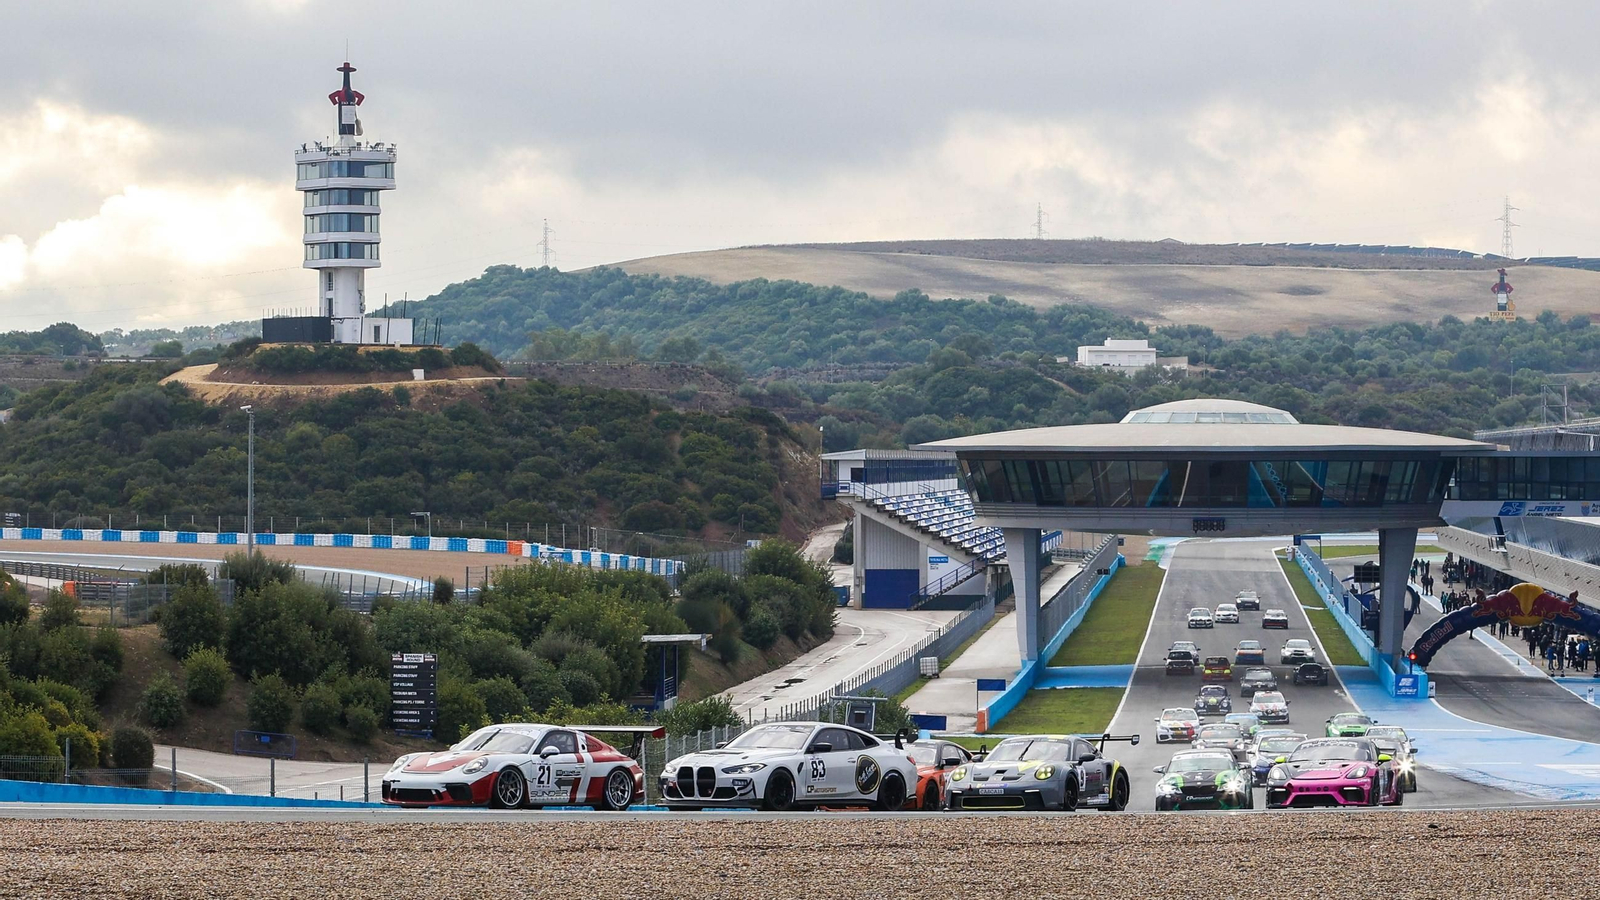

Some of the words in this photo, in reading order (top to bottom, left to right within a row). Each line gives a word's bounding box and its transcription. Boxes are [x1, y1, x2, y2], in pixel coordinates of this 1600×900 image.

[1420, 633, 1441, 652] Red
[1434, 620, 1454, 640] Bull
[537, 765, 551, 785] 21
[810, 760, 826, 778] 83
